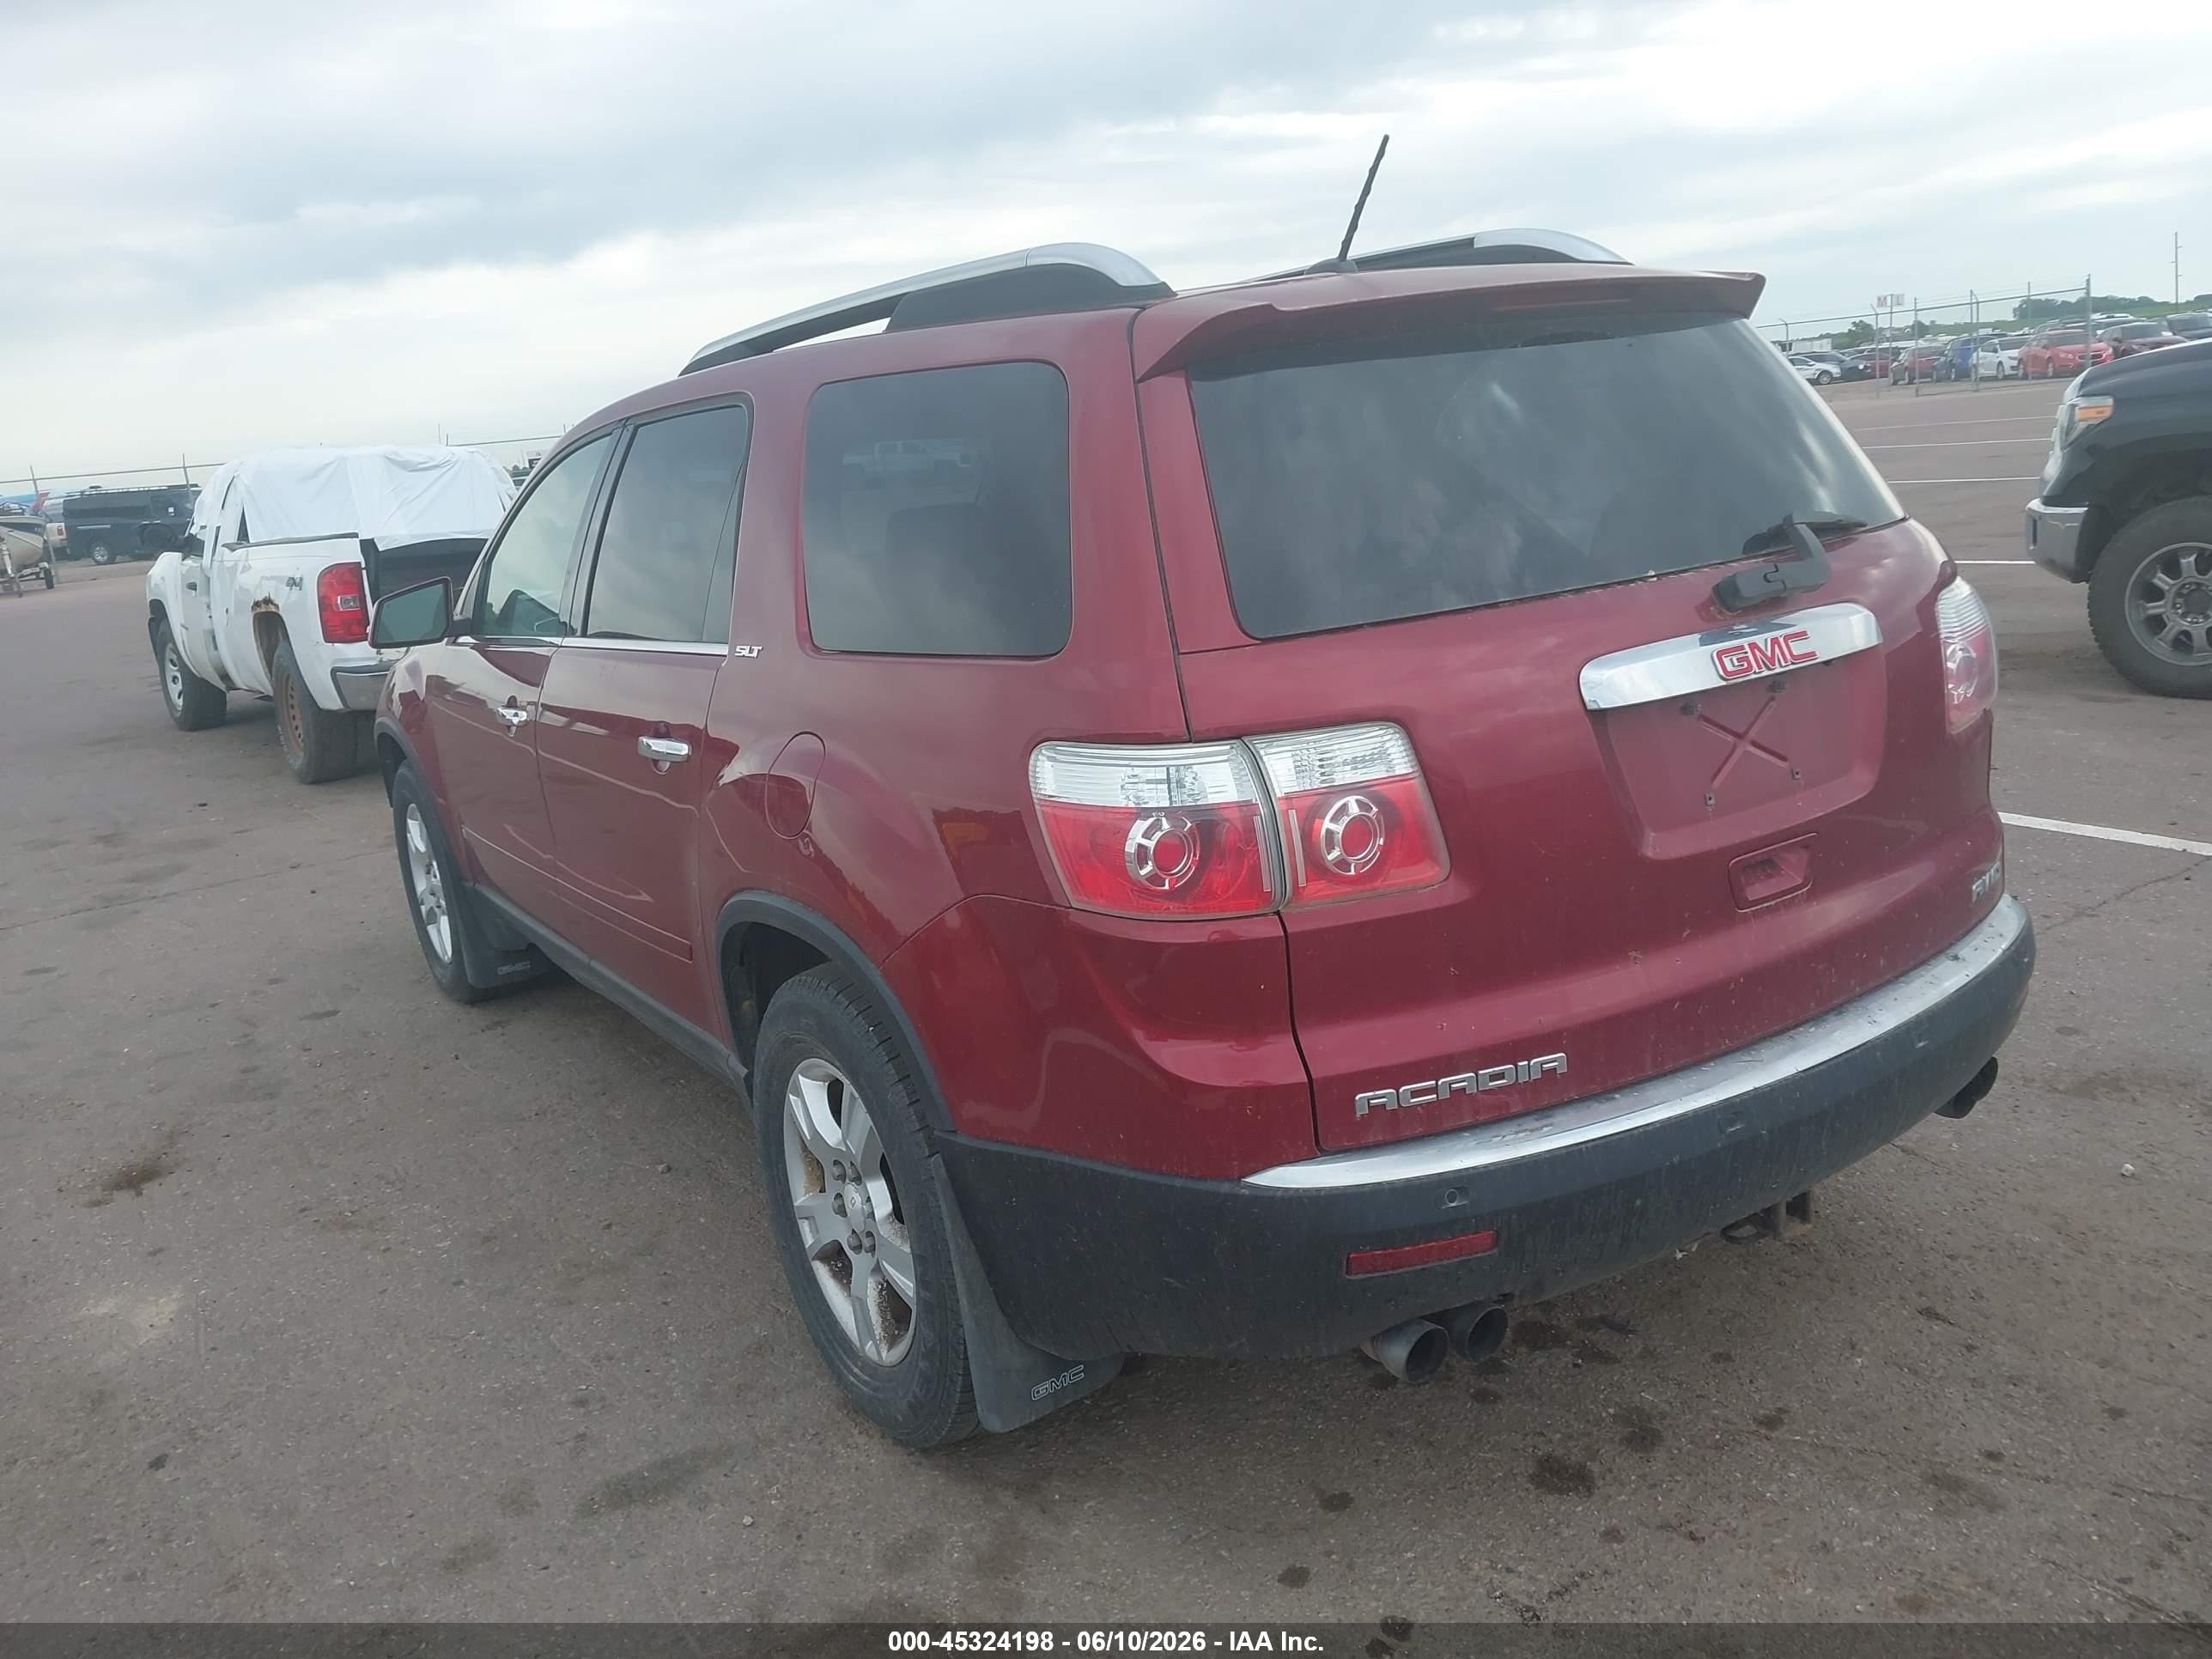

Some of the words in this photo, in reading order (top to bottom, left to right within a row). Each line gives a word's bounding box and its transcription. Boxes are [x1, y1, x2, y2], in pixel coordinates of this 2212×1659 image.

[734, 645, 763, 659] SLT
[1713, 630, 1818, 680] GMC
[1355, 1052, 1568, 1115] ACADIA
[1030, 1364, 1085, 1401] GMC
